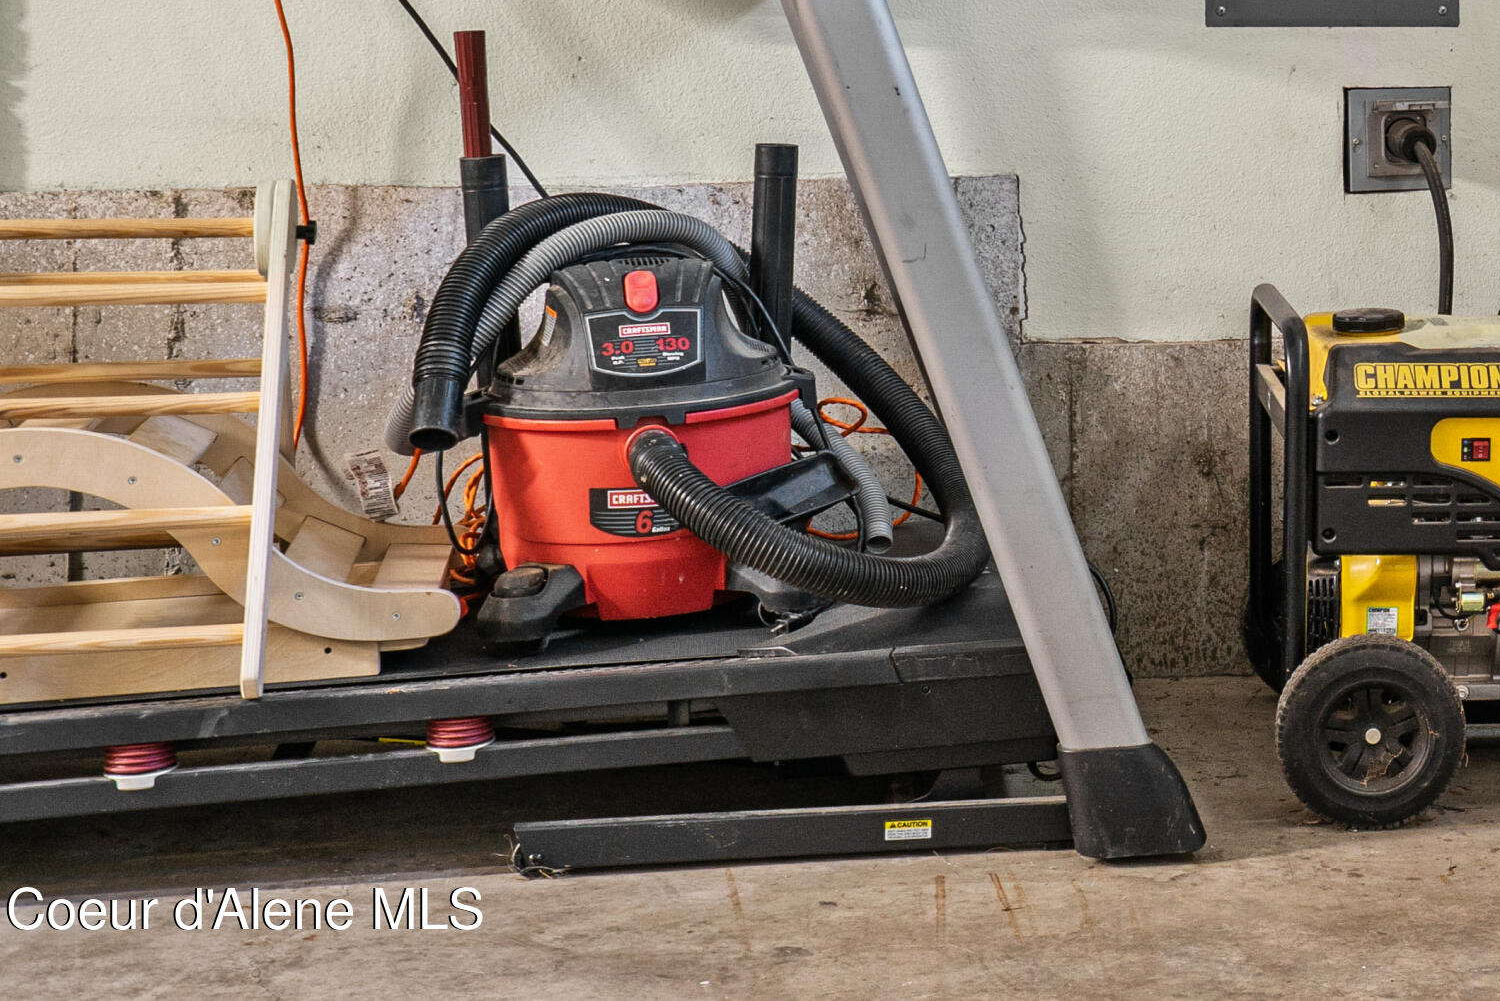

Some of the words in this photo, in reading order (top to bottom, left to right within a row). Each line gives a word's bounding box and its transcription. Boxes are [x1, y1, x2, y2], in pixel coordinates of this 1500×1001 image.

[622, 325, 667, 334] CRAFTSMAN
[601, 340, 634, 356] 3.0
[656, 337, 690, 351] 130
[612, 494, 654, 504] CRAFTS
[636, 510, 653, 533] 6
